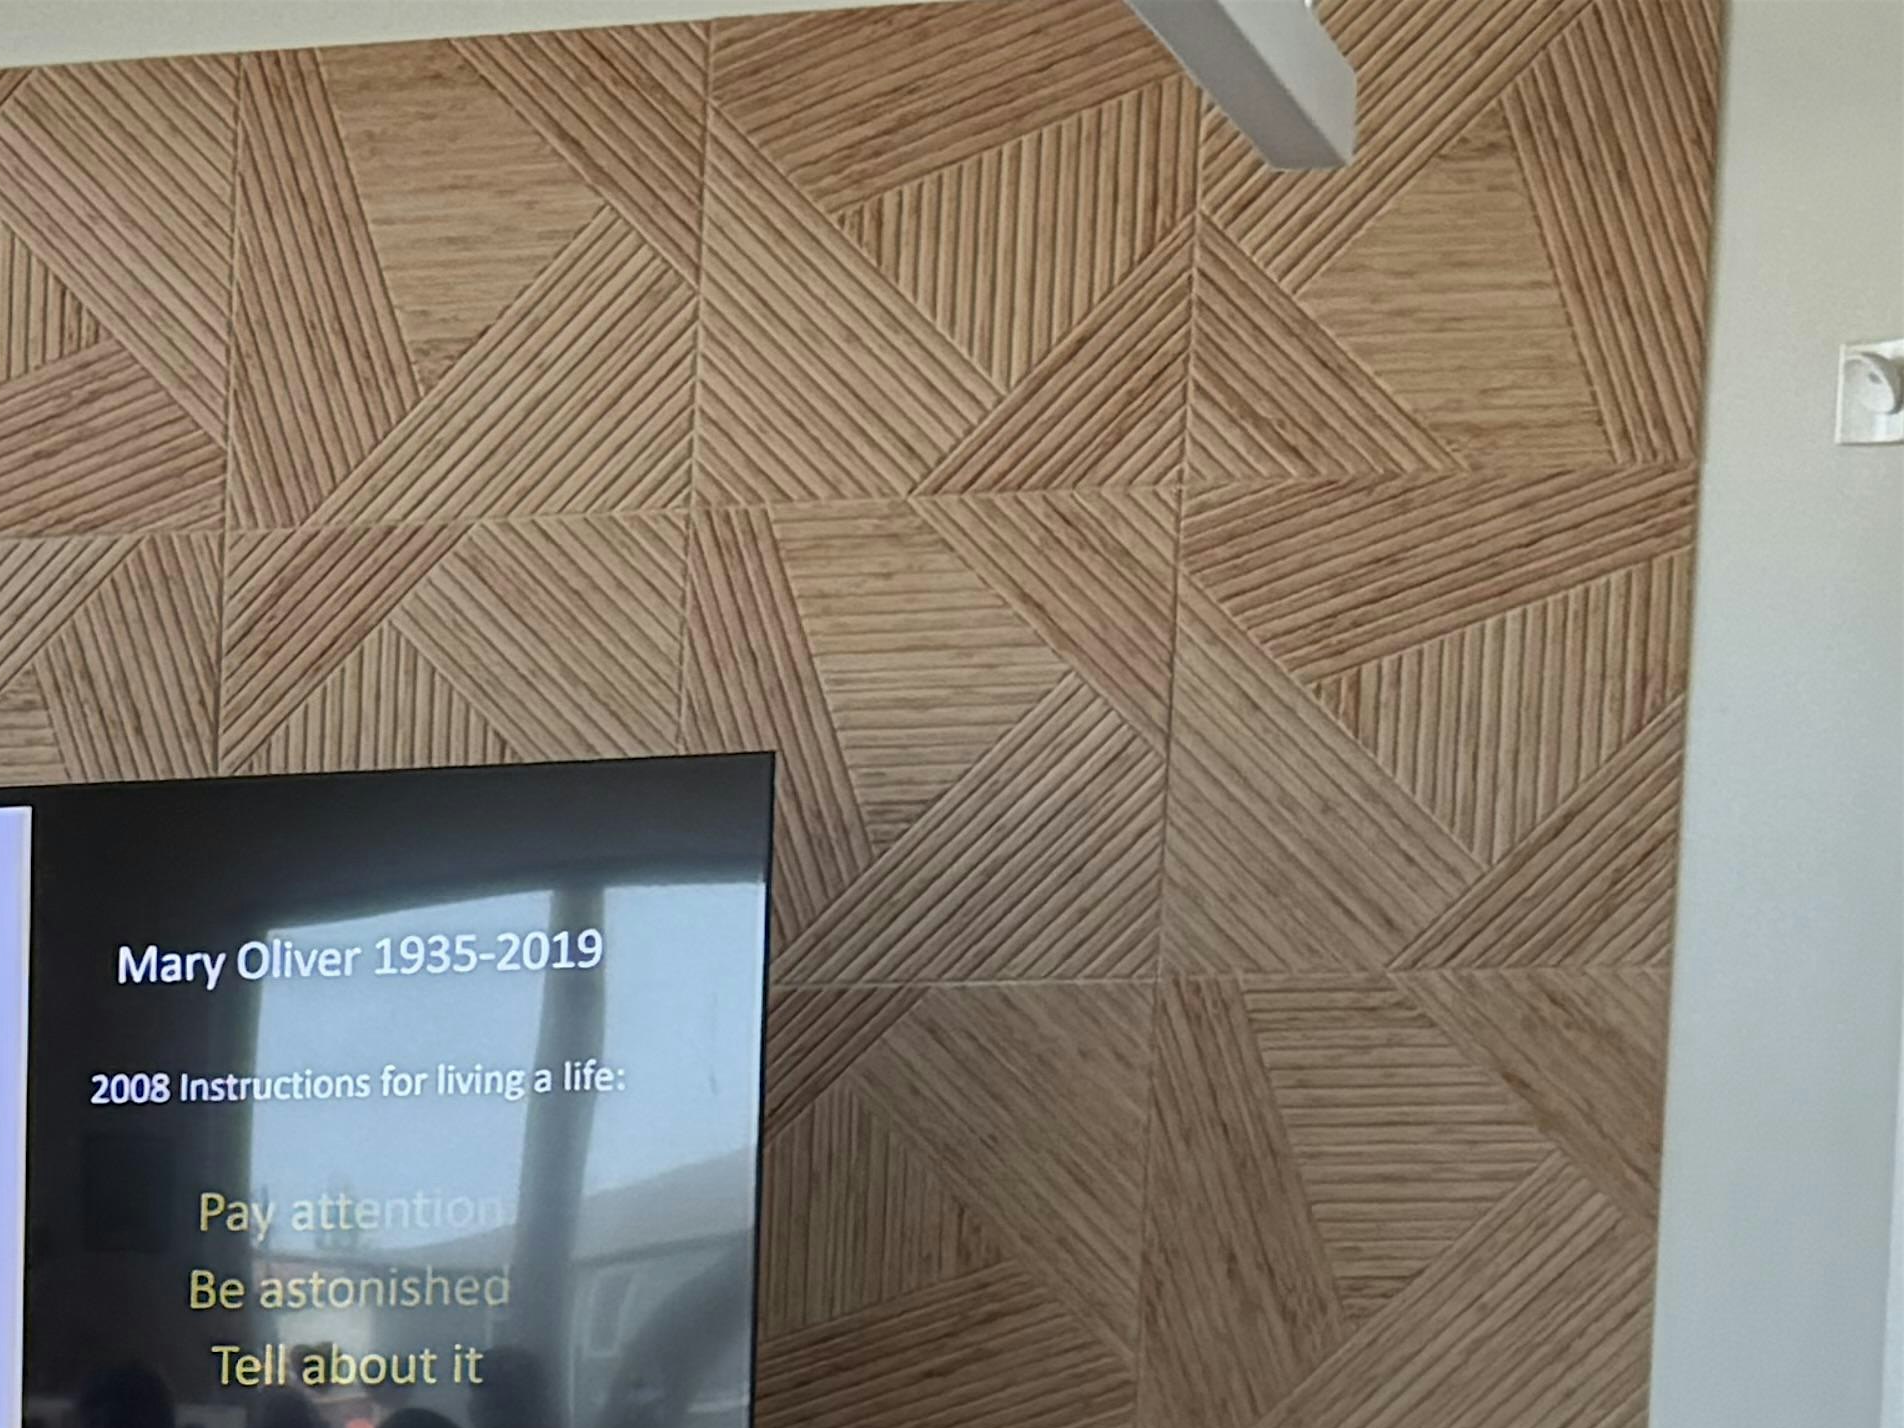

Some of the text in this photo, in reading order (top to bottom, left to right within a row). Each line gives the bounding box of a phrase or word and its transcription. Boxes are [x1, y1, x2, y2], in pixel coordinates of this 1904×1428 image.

[117, 928, 604, 990] Mary Oliver 1935-2019
[91, 1060, 627, 1104] 2008 Instructions for living a life:
[199, 1189, 502, 1241] Pay attention
[190, 1266, 512, 1310] Be astonished
[211, 1345, 484, 1386] Tell about it
